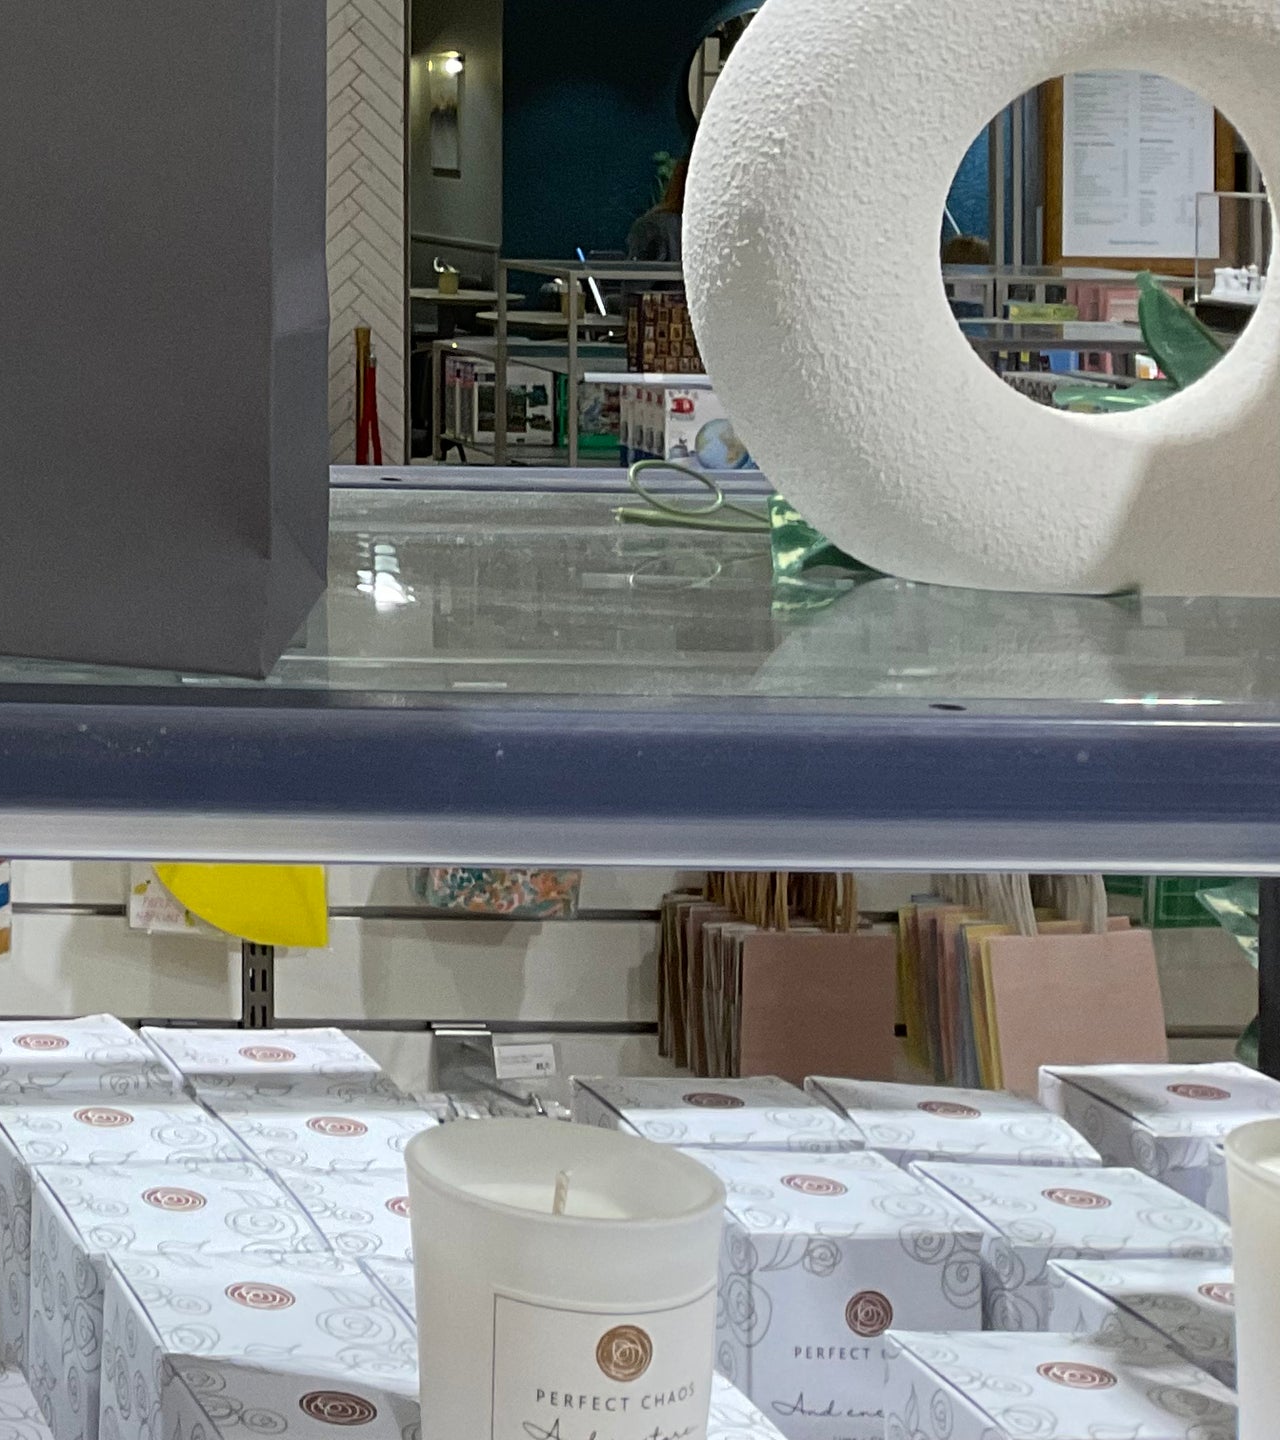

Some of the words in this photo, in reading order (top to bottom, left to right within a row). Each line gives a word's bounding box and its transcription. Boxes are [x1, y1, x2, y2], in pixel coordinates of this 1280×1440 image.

[794, 1346, 871, 1361] PERFECT
[536, 1388, 631, 1412] PERFECT
[640, 1381, 696, 1410] CHAOS
